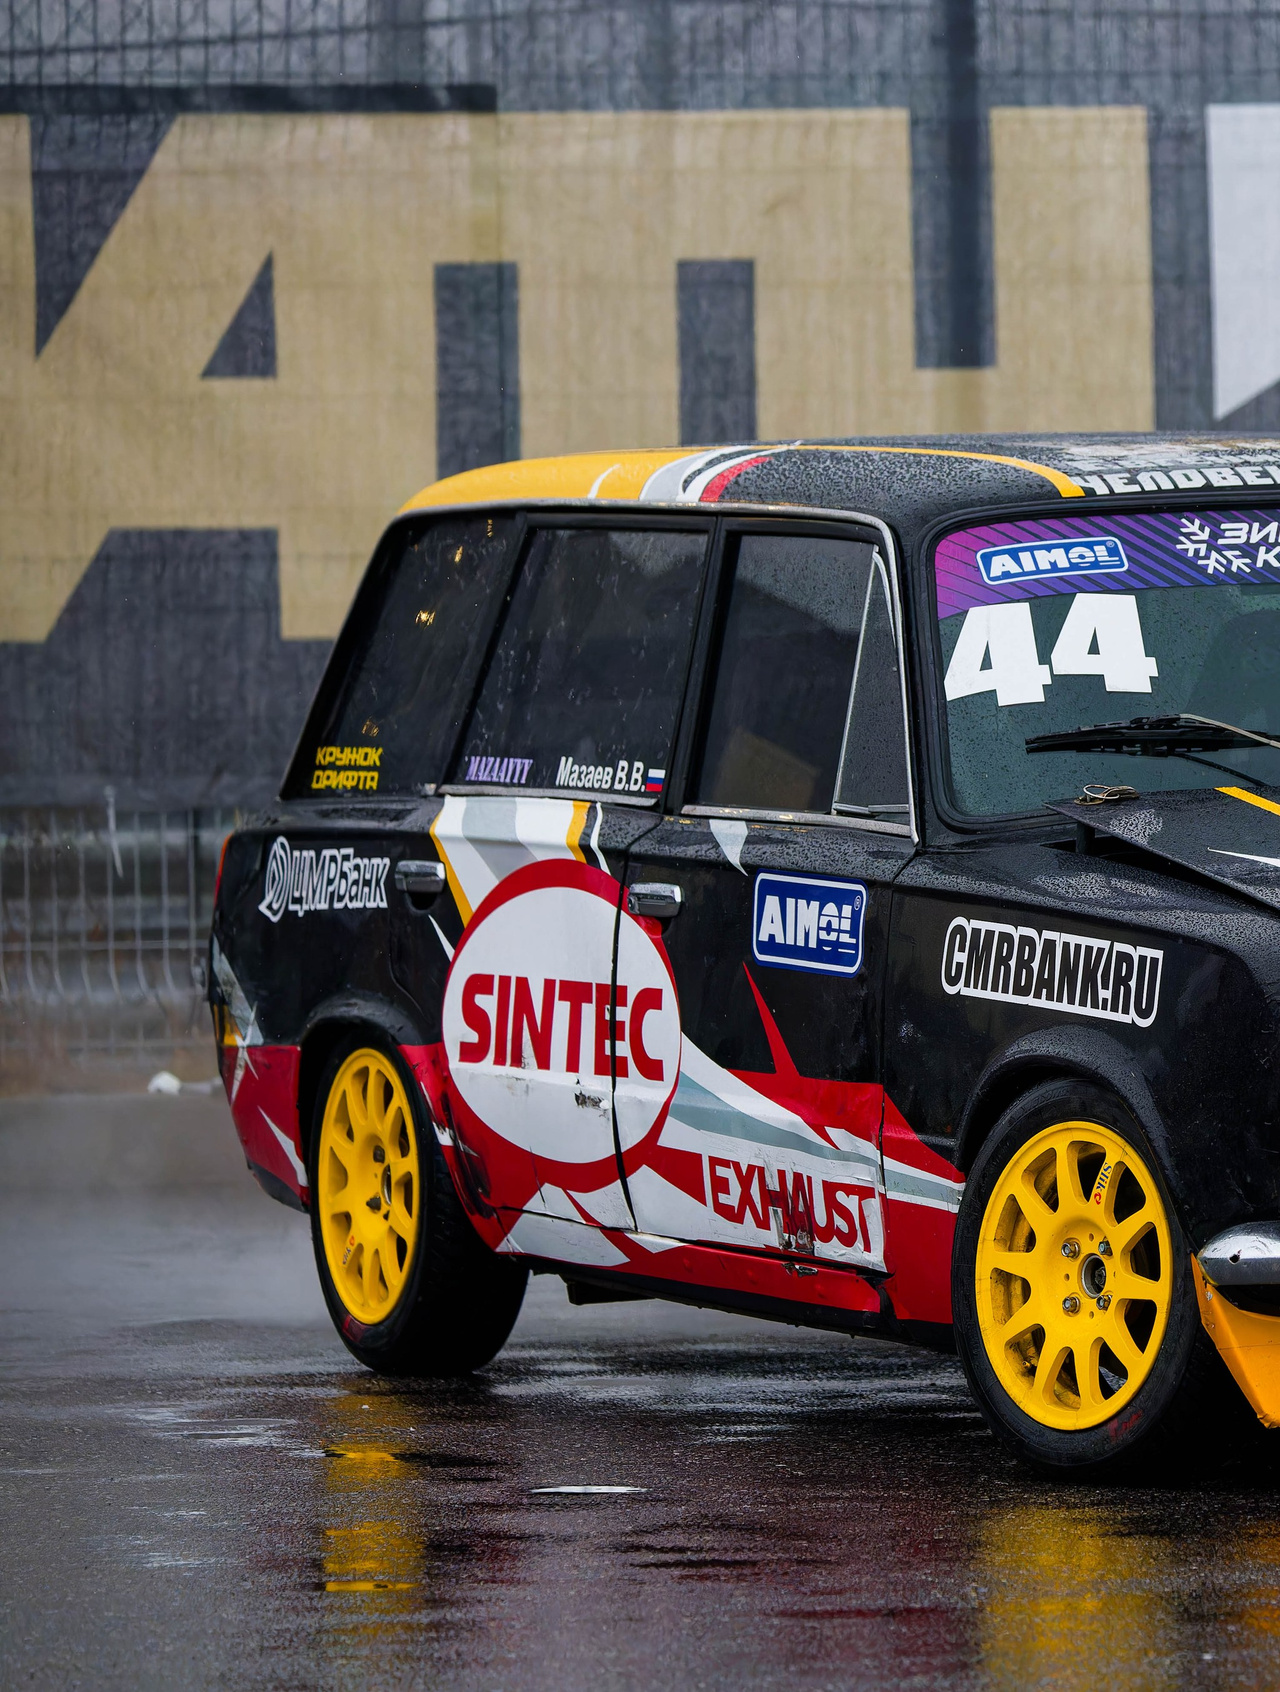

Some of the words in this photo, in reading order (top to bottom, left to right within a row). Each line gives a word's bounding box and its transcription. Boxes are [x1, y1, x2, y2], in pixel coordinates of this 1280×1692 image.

[989, 545, 1121, 577] AIMOL
[943, 592, 1159, 706] 44
[311, 770, 379, 790] ДРИФТА
[315, 746, 383, 767] КРУЖОК
[555, 756, 613, 789] Мазаев
[758, 894, 857, 955] AIMOL
[458, 973, 664, 1081] SINTEC
[708, 1155, 877, 1254] EXHAUST
